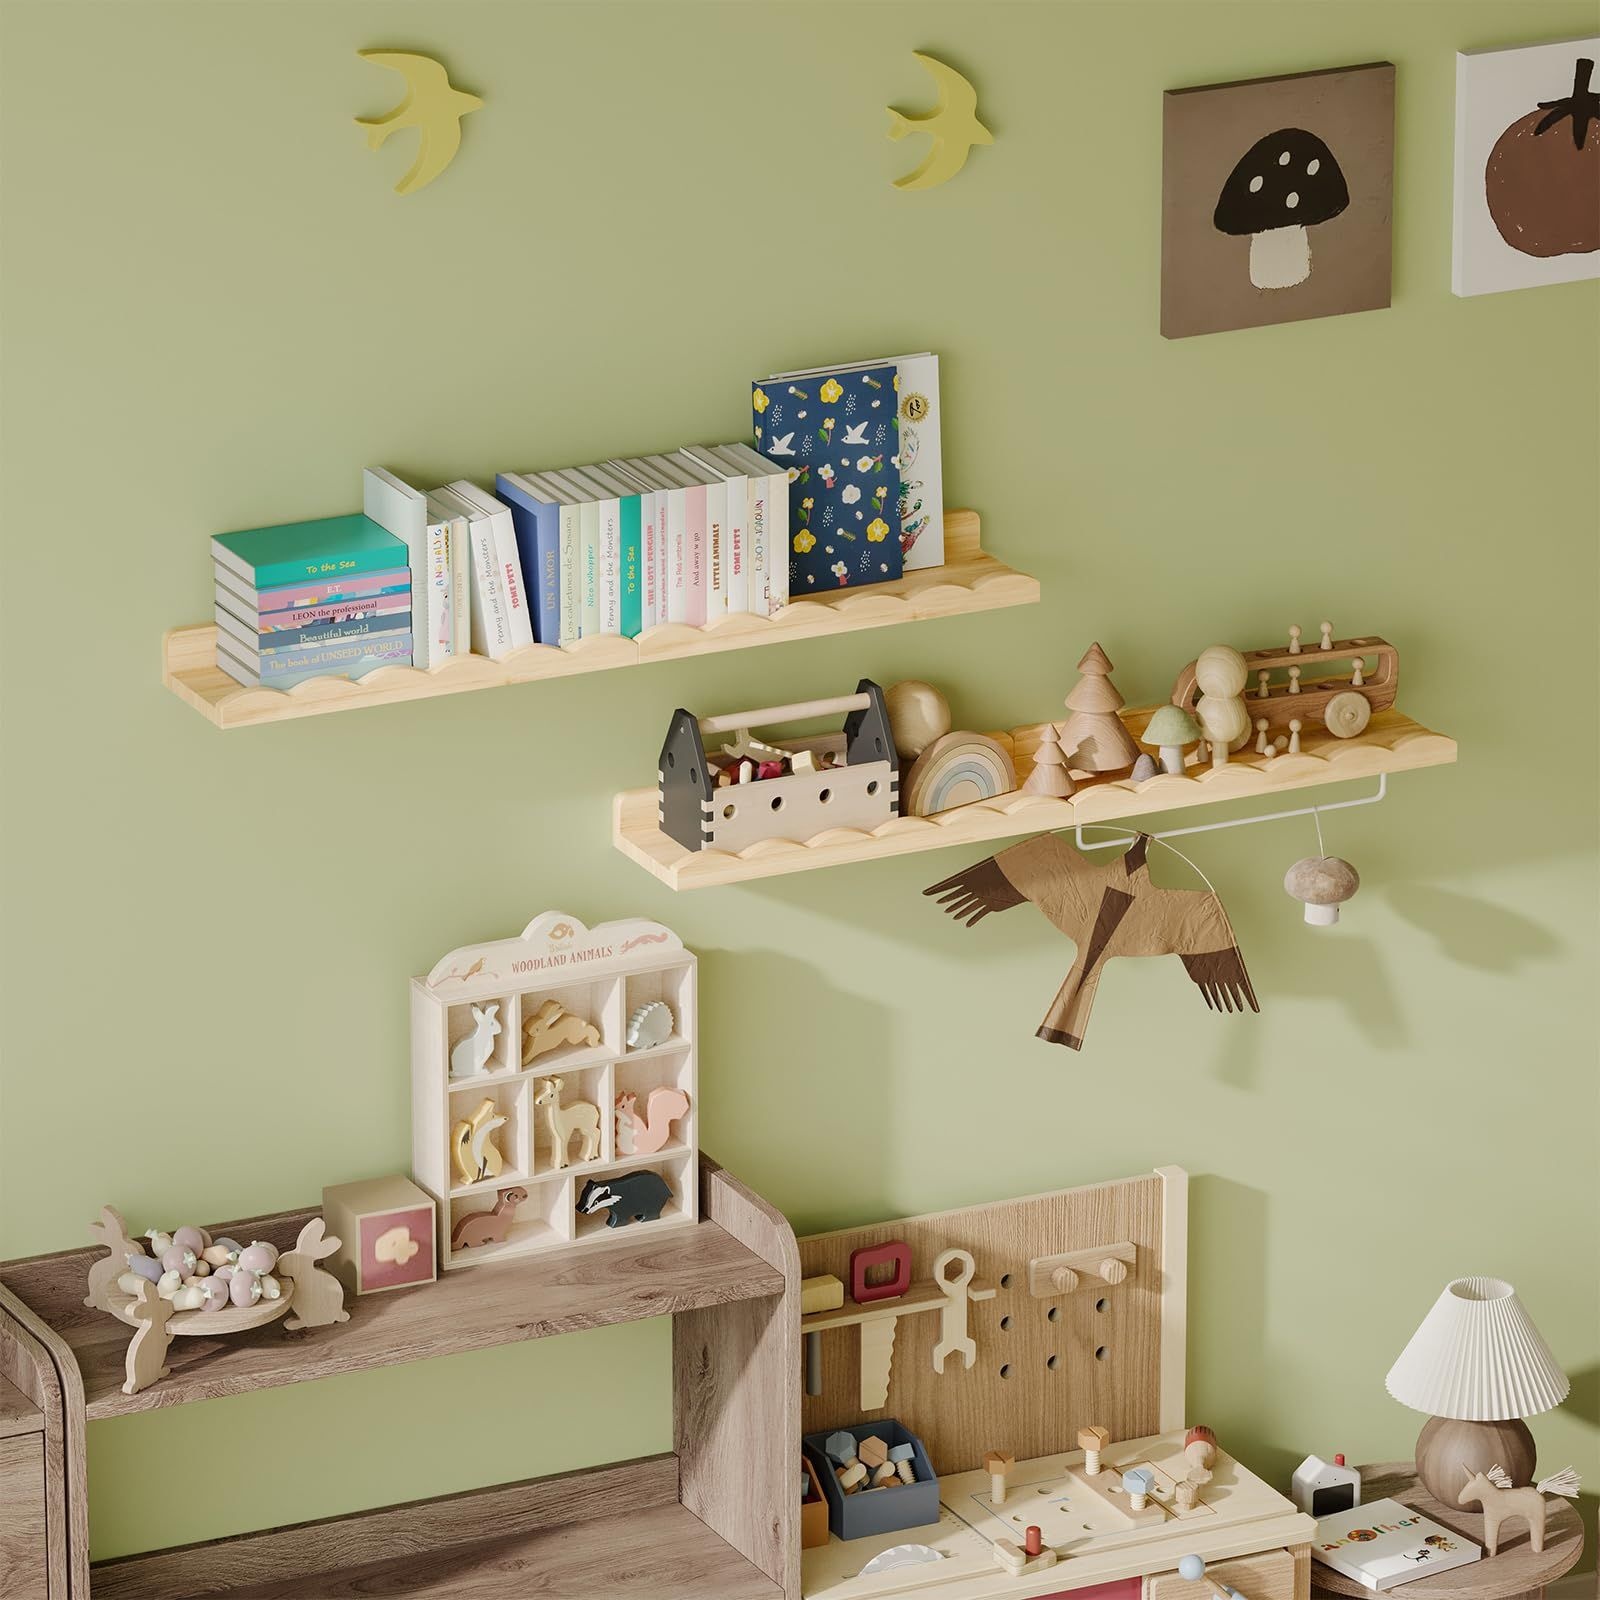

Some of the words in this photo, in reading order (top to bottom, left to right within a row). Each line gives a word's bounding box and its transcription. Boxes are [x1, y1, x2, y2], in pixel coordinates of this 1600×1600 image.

[606, 518, 614, 559] Monsters
[694, 532, 701, 542] go
[306, 566, 318, 574] To
[321, 563, 335, 572] the
[339, 560, 356, 569] Sea
[480, 538, 494, 578] Monsters
[562, 557, 573, 570] de
[587, 543, 596, 585] Whopper
[505, 563, 517, 585] PETS
[547, 551, 555, 587] AMOR
[606, 561, 614, 577] the
[628, 565, 636, 580] the
[327, 585, 342, 594] E.T.
[488, 581, 497, 595] the
[510, 586, 520, 609] SOME
[627, 582, 635, 594] To
[492, 599, 500, 614] and
[548, 591, 556, 609] UN
[292, 610, 316, 621] LEON
[318, 608, 331, 617] the
[332, 601, 377, 617] professional
[607, 599, 616, 628] Penny
[300, 629, 342, 643] Beautiful
[344, 624, 369, 637] world
[495, 616, 505, 644] Penny
[270, 660, 286, 670] The
[288, 656, 309, 667] book
[363, 641, 404, 656] WORLD
[512, 954, 567, 974] WOODLAND
[570, 945, 613, 963] ANIMALS
[1321, 1516, 1421, 1551] another
